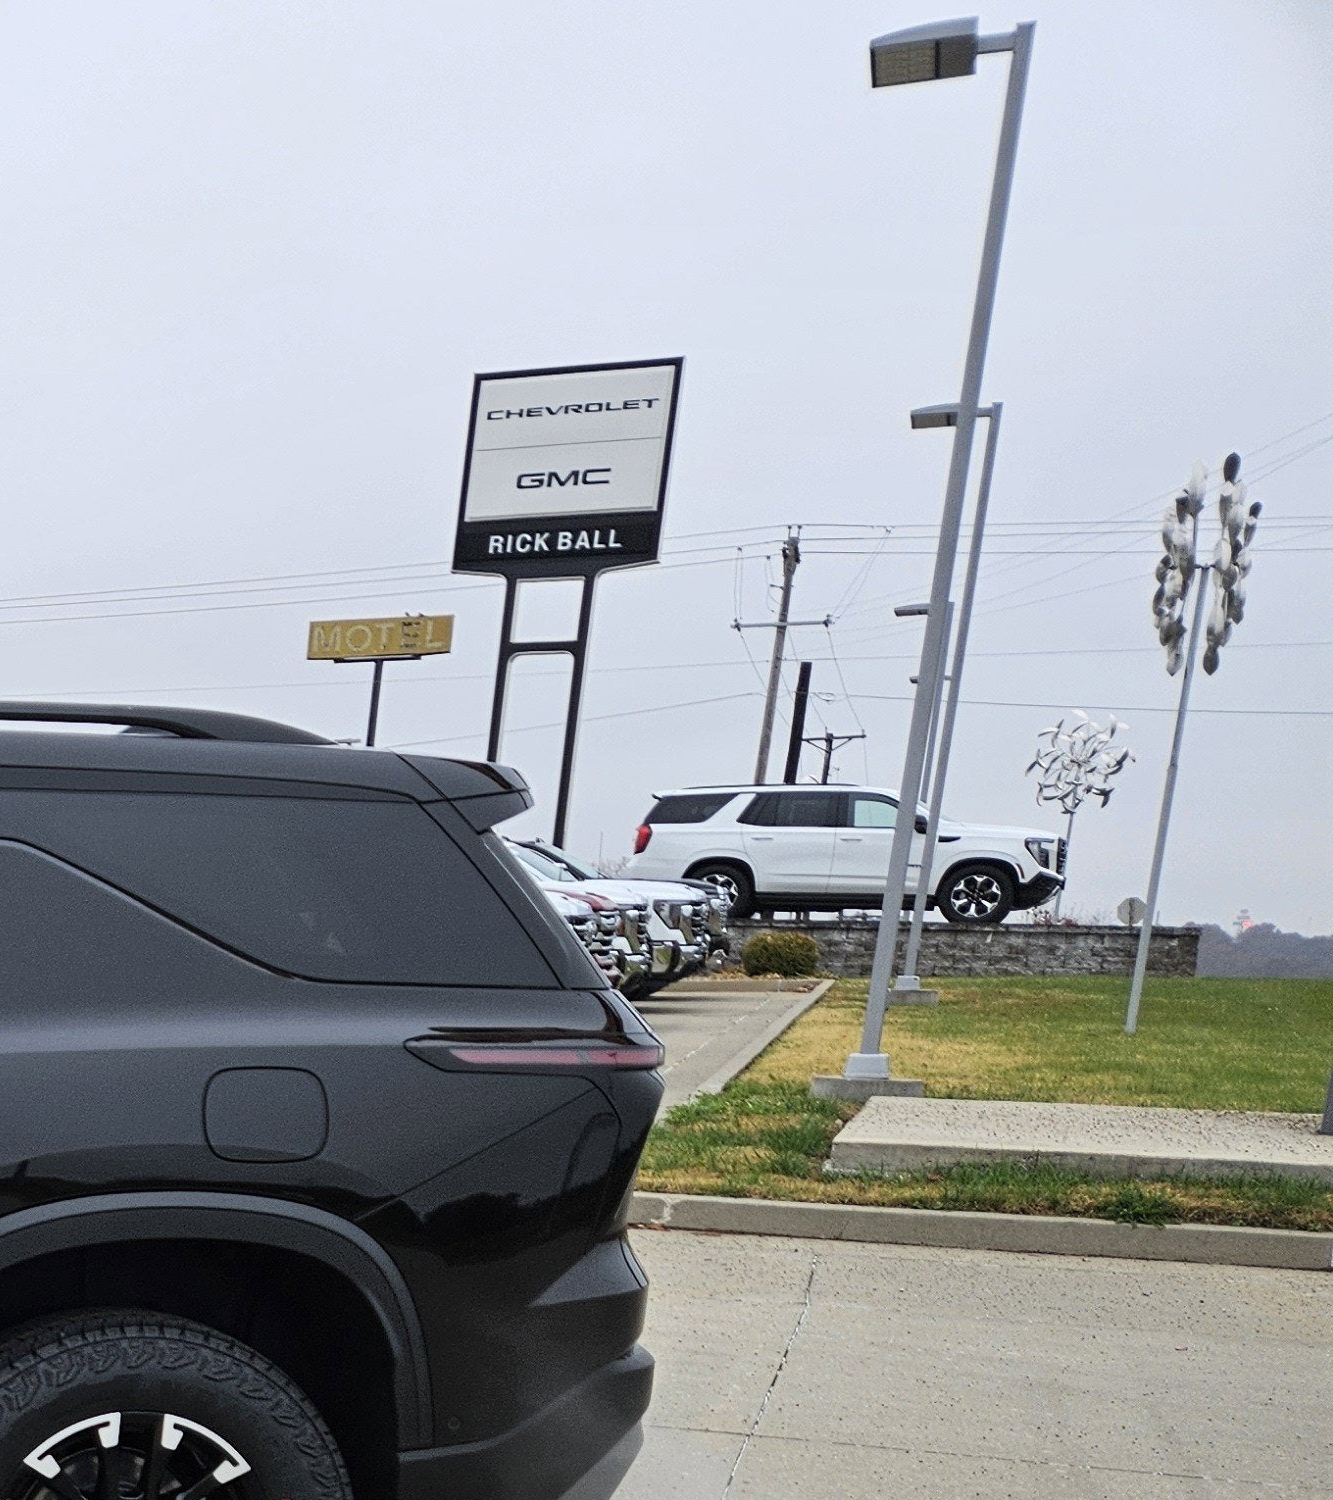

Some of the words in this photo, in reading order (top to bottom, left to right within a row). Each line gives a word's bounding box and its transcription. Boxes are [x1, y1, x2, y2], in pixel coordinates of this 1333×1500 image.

[486, 397, 660, 421] CHEVROLET
[515, 467, 612, 490] GMC
[487, 531, 551, 555] RICK
[556, 529, 623, 551] BALL
[311, 618, 447, 653] MOTEL
